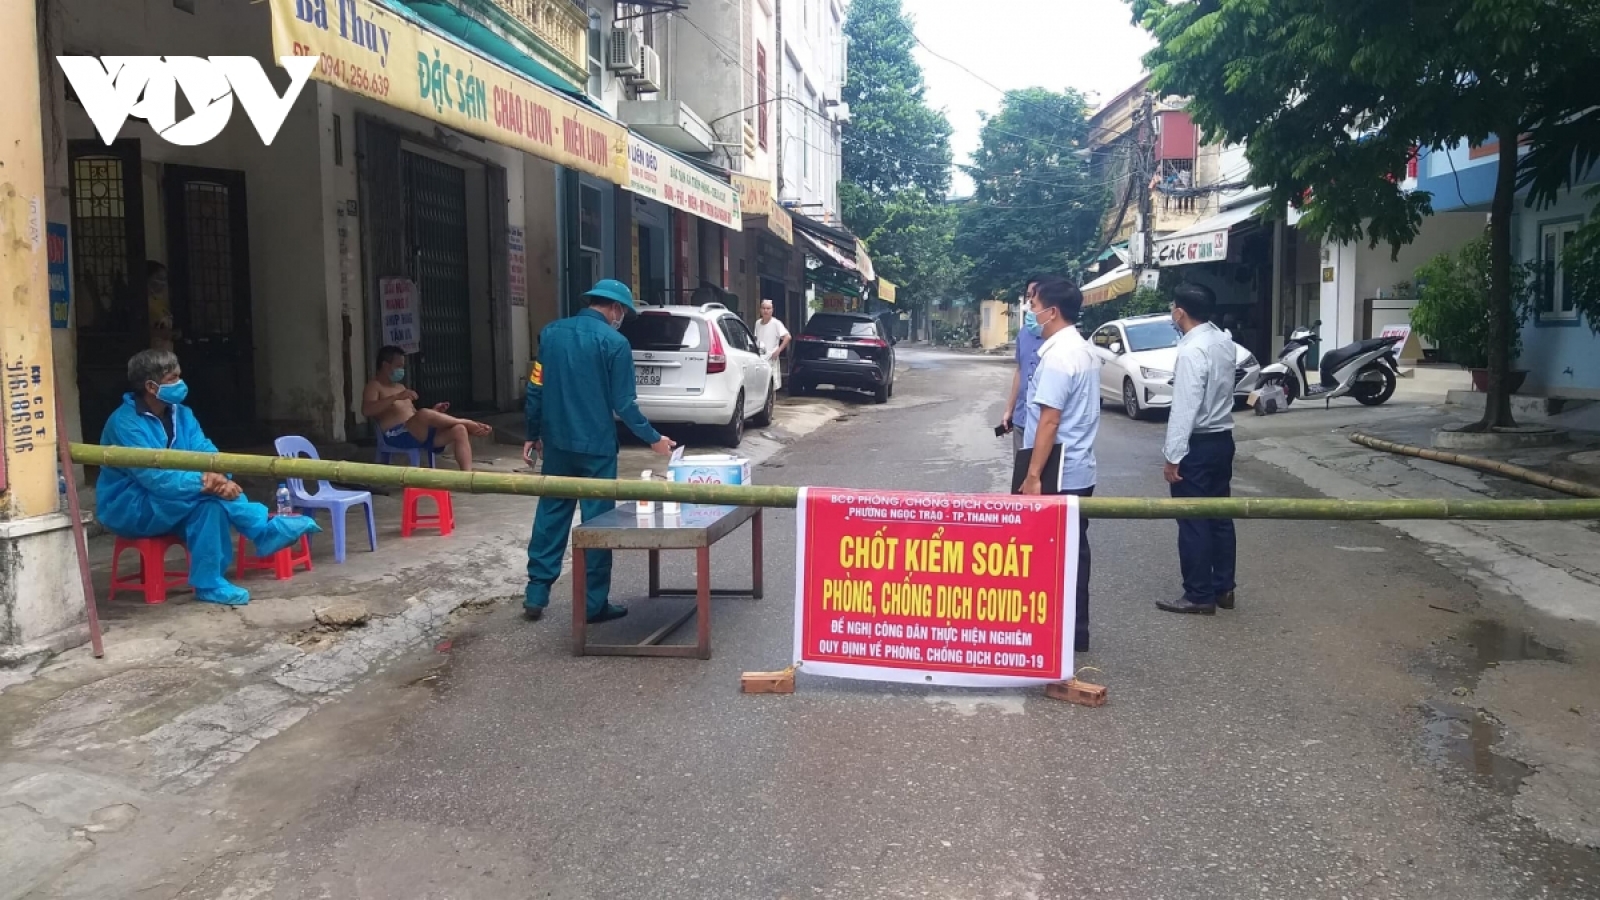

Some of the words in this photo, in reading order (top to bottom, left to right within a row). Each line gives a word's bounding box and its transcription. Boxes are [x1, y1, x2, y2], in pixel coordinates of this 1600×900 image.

[320, 52, 390, 97] 0941.256.639
[417, 47, 452, 113] ĐẶC
[456, 59, 488, 122] SẢN
[493, 81, 523, 135] CHÁO
[562, 109, 585, 157] MIẾN
[831, 494, 854, 504] BCĐ
[953, 499, 981, 509] DỊCH
[984, 501, 1042, 512] COVID-19
[849, 506, 887, 518] PHƯỜNG
[890, 509, 916, 521] NGỌC
[952, 512, 999, 523] TP.THANH
[840, 525, 899, 570] CHỐT
[905, 526, 964, 574] KIỂM
[971, 537, 1033, 578] SOÁT
[823, 572, 877, 617] PHÒNG,
[881, 571, 932, 617] CHỐNG
[936, 586, 972, 625] DỊCH
[976, 587, 1047, 624] COVID-19
[847, 620, 872, 639] NGHỊ
[875, 620, 904, 639] CÔNG
[906, 623, 928, 640] DÂN
[931, 627, 958, 645] THỰC
[961, 626, 986, 646] HIỆN
[989, 629, 1033, 647] NGHIÊM
[819, 639, 839, 654] QUY
[842, 641, 867, 658] ĐỊNH
[926, 645, 963, 663] CHỐNG
[966, 650, 991, 668] DỊCH
[994, 652, 1044, 669] COVID-19
